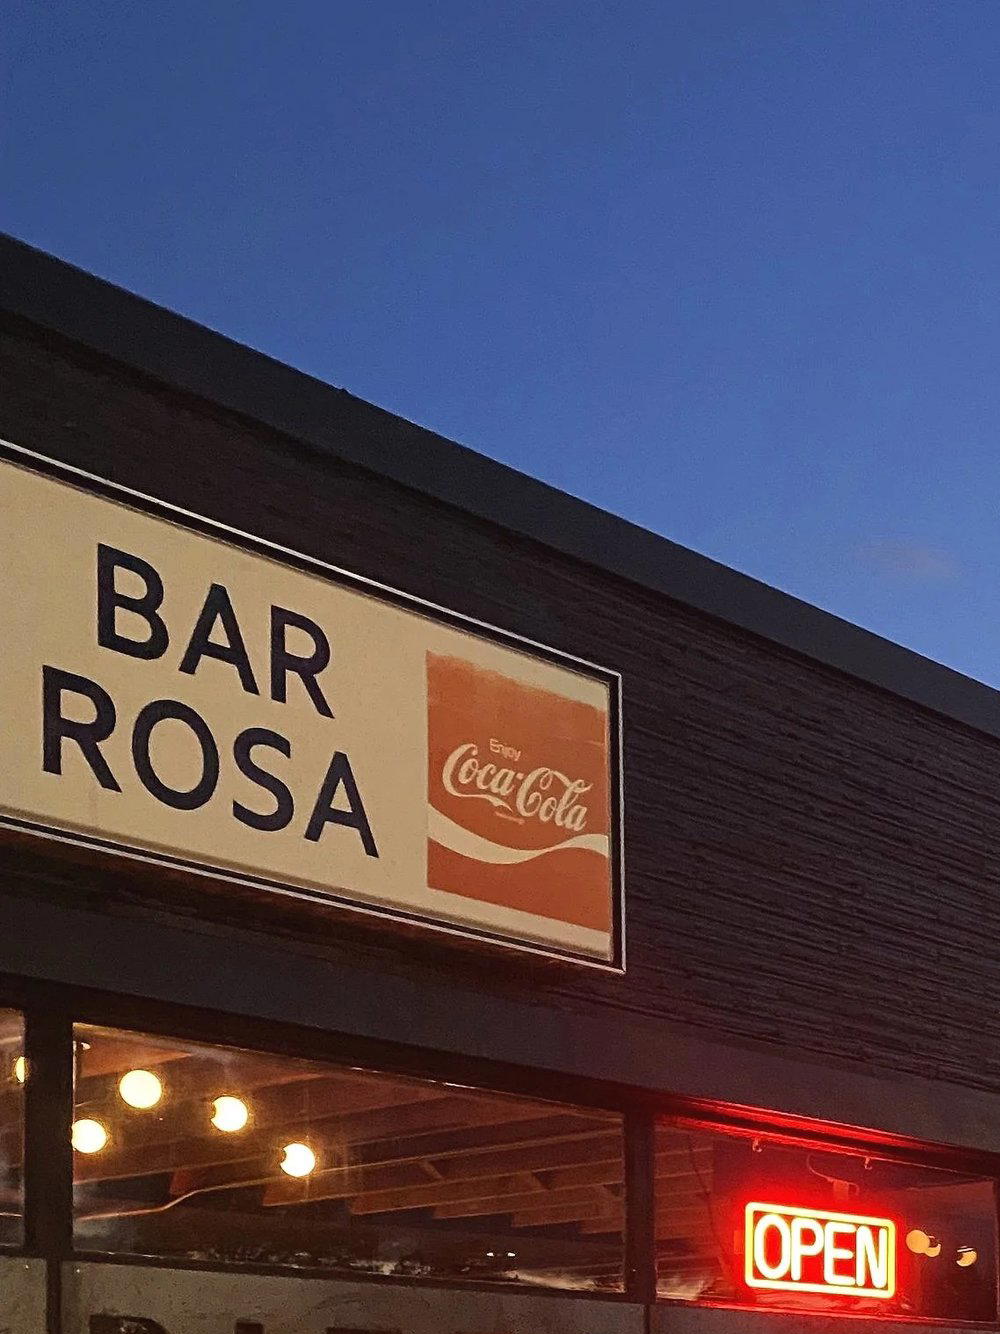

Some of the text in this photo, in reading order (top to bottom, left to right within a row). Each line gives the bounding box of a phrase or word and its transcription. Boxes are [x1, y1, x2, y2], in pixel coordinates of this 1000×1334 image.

[96, 542, 335, 719] BAR
[41, 664, 380, 859] ROSA
[442, 743, 594, 832] Coca-Cola
[753, 1213, 889, 1289] OPEN
